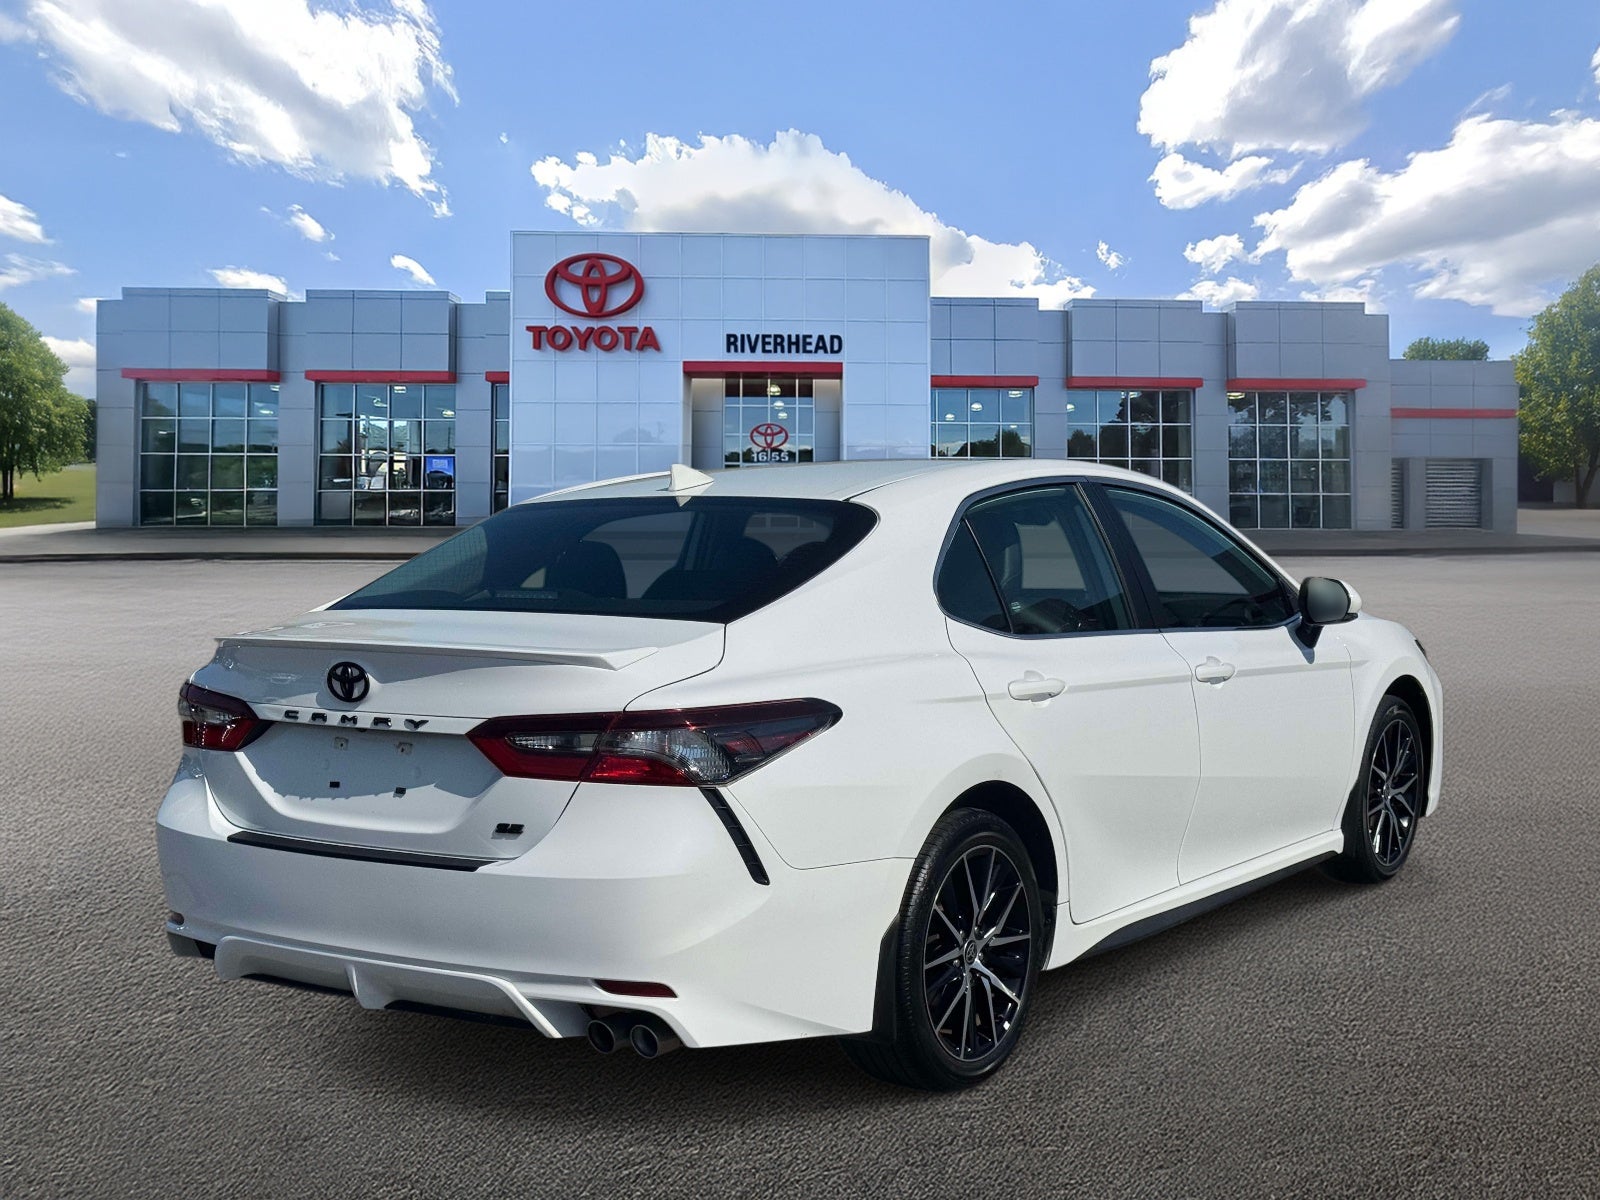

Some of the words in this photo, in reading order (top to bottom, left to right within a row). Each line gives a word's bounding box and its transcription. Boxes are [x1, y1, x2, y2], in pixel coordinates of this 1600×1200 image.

[525, 325, 661, 351] TOYOTA
[726, 333, 843, 354] RIVERHEAD
[284, 709, 429, 729] CAMRY
